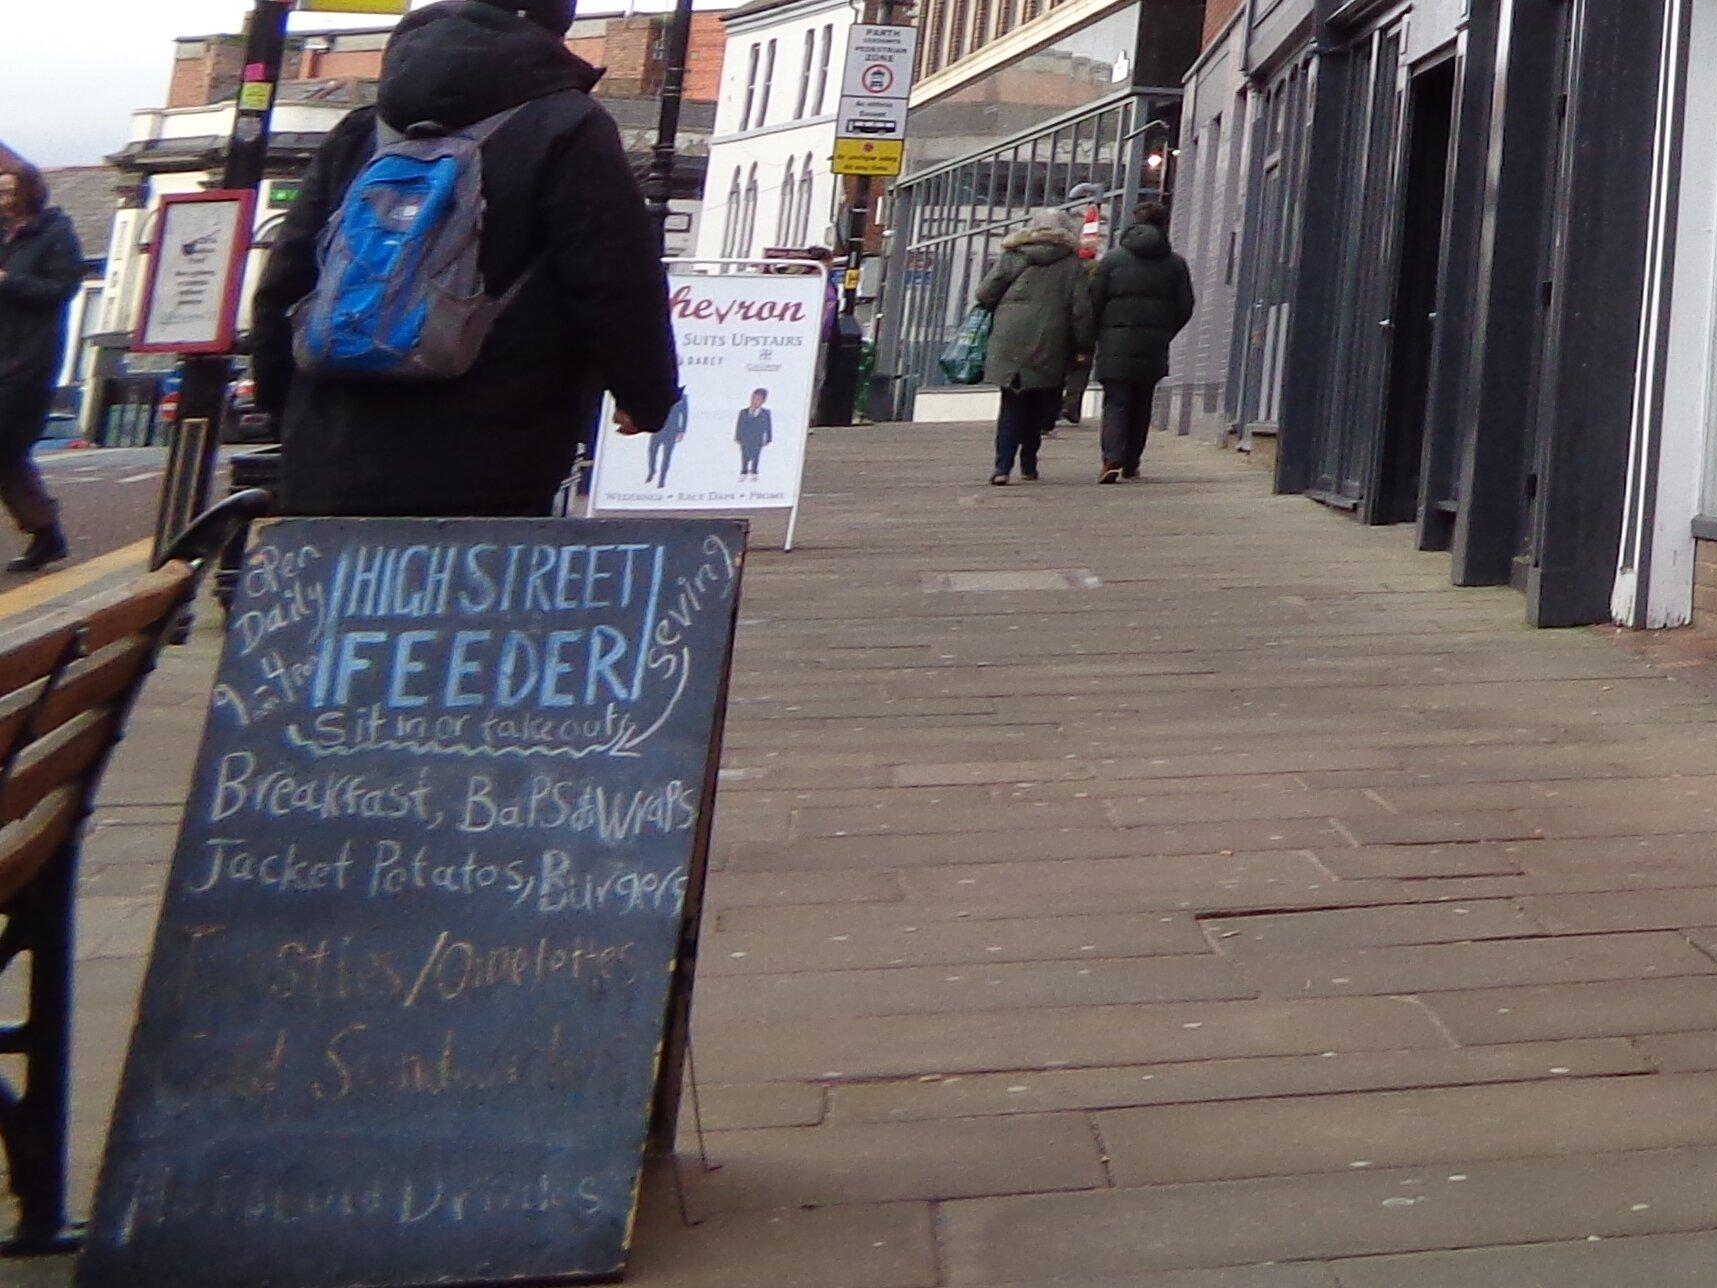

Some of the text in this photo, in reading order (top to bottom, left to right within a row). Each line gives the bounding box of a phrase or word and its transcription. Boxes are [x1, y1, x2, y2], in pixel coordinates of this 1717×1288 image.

[669, 285, 806, 324] hevron
[347, 544, 650, 616] HIGH STREET
[332, 625, 631, 708] FEEDER
[315, 702, 388, 746] Sit
[196, 837, 354, 893] Jacket
